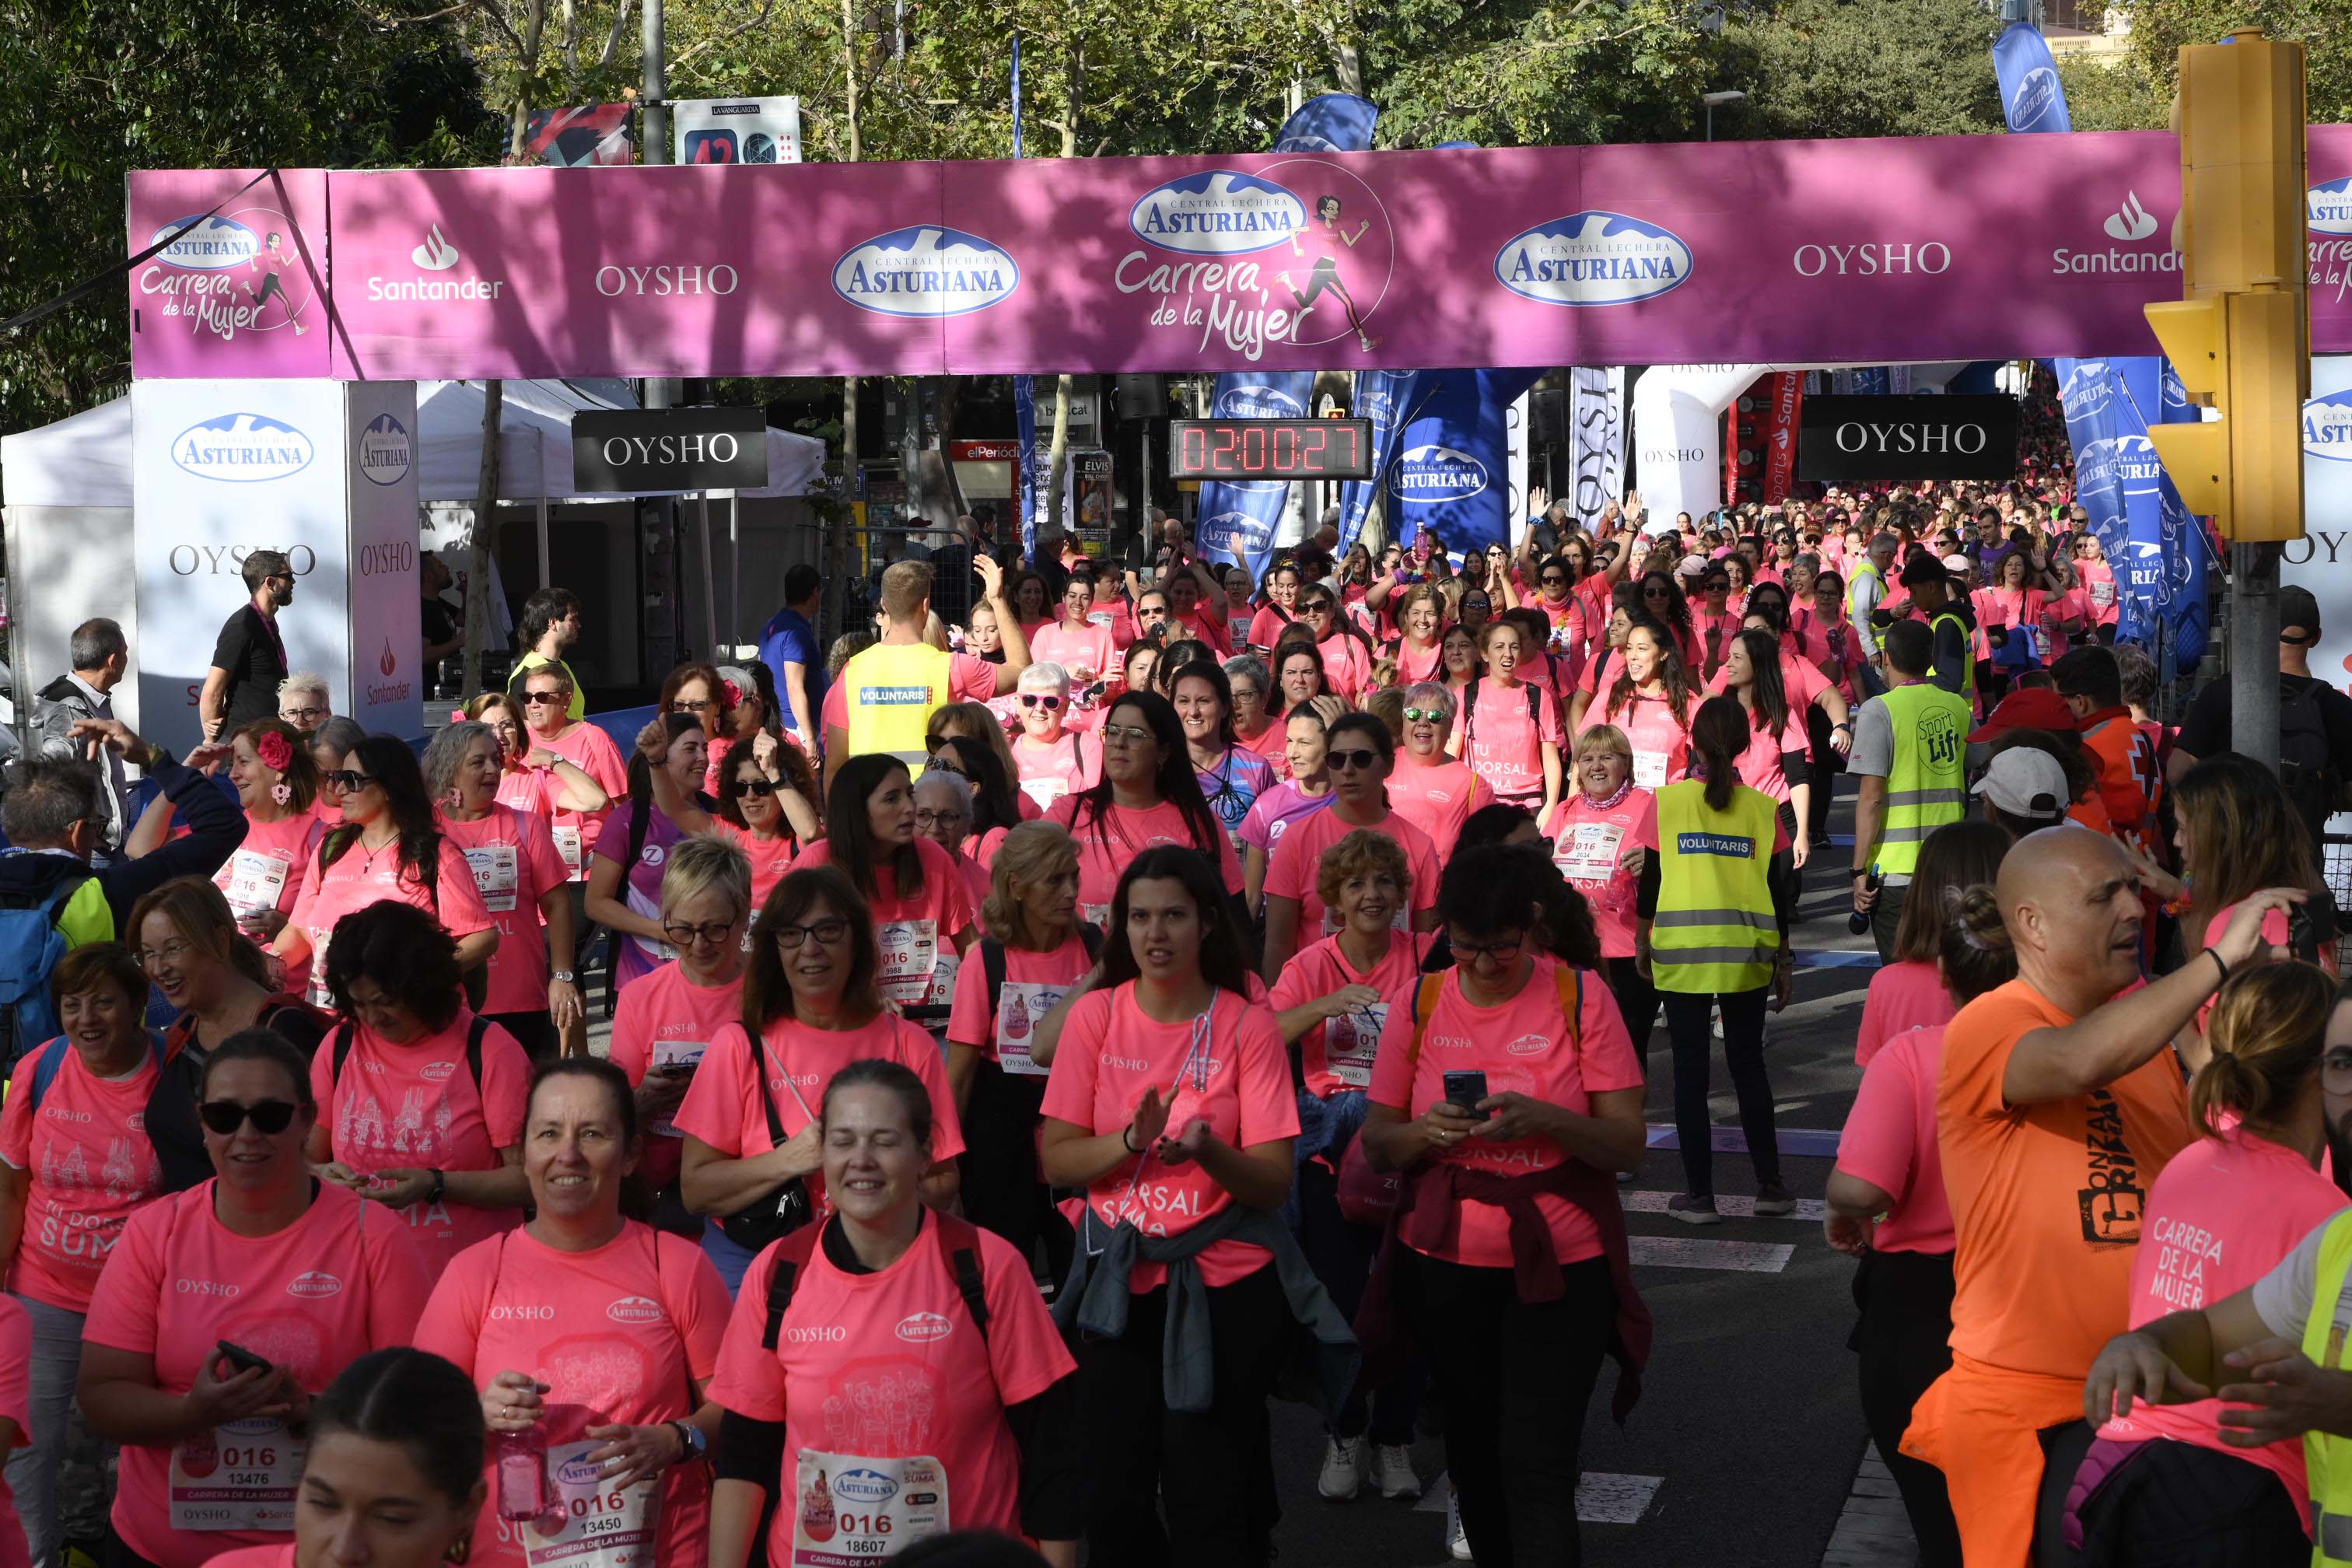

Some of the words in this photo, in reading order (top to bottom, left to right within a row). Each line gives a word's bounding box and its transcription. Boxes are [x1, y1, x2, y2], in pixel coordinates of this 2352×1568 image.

[721, 105, 760, 114] VANGUARDIA
[1171, 199, 1227, 208] CENTRAL
[1231, 197, 1288, 208] LECHERA
[1143, 201, 1293, 233] ASTURIANA
[158, 234, 251, 257] ASTURIANA
[1540, 243, 1601, 255] CENTRAL
[1608, 242, 1671, 253] LECHERA
[874, 256, 933, 266] CENTRAL
[941, 255, 998, 266] LECHERA
[1509, 247, 1678, 283] ASTURIANA
[1794, 242, 1951, 277] OYSHO
[139, 265, 232, 297] Carrera
[595, 264, 739, 297] OYSHO
[846, 263, 1005, 294] ASTURIANA
[1115, 250, 1261, 294] Carrera
[2325, 263, 2340, 285] la
[367, 275, 504, 302] Santander
[162, 295, 180, 317] de
[182, 296, 195, 317] la
[193, 292, 266, 341] Mujer
[1150, 294, 1178, 327] de
[1184, 296, 1203, 326] la
[1198, 286, 1315, 362] Mujer
[1835, 422, 1987, 454] OYSHO
[183, 438, 303, 465] ASTURIANA
[362, 439, 408, 468] ASTURIANA
[603, 432, 739, 467] OYSHO
[1182, 427, 1356, 471] 02:00:27
[1644, 447, 1705, 464] OYSHO
[1084, 460, 1109, 472] ELVIS
[1439, 463, 1478, 471] LECHERA
[1392, 471, 1482, 491] ASTURIANA
[1206, 524, 1268, 549] ASTUANA
[169, 544, 317, 577] OYSO
[361, 541, 412, 576] OYSHO
[367, 680, 411, 706] Santander
[860, 690, 926, 702] VOLUNTARIS
[1918, 711, 1955, 740] Sport
[1473, 744, 1489, 757] TU
[1474, 761, 1528, 775] DORSAL
[1575, 842, 1596, 851] 016
[1678, 838, 1749, 852] VOLUNTARIS
[473, 870, 491, 881] 16
[882, 952, 909, 965] 016
[1360, 1033, 1378, 1047] 01
[1510, 1041, 1550, 1054] ASTURIANA
[1101, 1053, 1149, 1072] OYSHO
[771, 1073, 819, 1091] OYSHO
[45, 1107, 92, 1124] OYSHO
[2152, 1216, 2223, 1266] CARRERA
[2158, 1246, 2179, 1275] DE
[2182, 1257, 2204, 1285] LA
[175, 1278, 240, 1297] OYSHO
[291, 1281, 339, 1293] ASTURIANA
[2150, 1272, 2203, 1311] MUJER
[490, 1306, 555, 1320] OYSHO
[611, 1305, 661, 1319] ASTURIANA
[787, 1326, 847, 1343] OYSHO
[901, 1323, 950, 1336] ASTURIANA
[223, 1447, 275, 1466] 016
[228, 1472, 269, 1485] 13476
[836, 1479, 894, 1495] ASTURIANA
[187, 1491, 229, 1500] CARRERA
[571, 1491, 625, 1517] 016
[184, 1509, 231, 1520] OYSHO
[840, 1513, 893, 1535] 016
[580, 1517, 622, 1535] 13450
[545, 1543, 586, 1558] CARRERA
[586, 1540, 600, 1550] DE
[601, 1537, 614, 1546] LA
[845, 1540, 887, 1553] 18607
[810, 1554, 847, 1567] CARRERA
[849, 1558, 862, 1567] DE
[863, 1559, 876, 1567] LA
